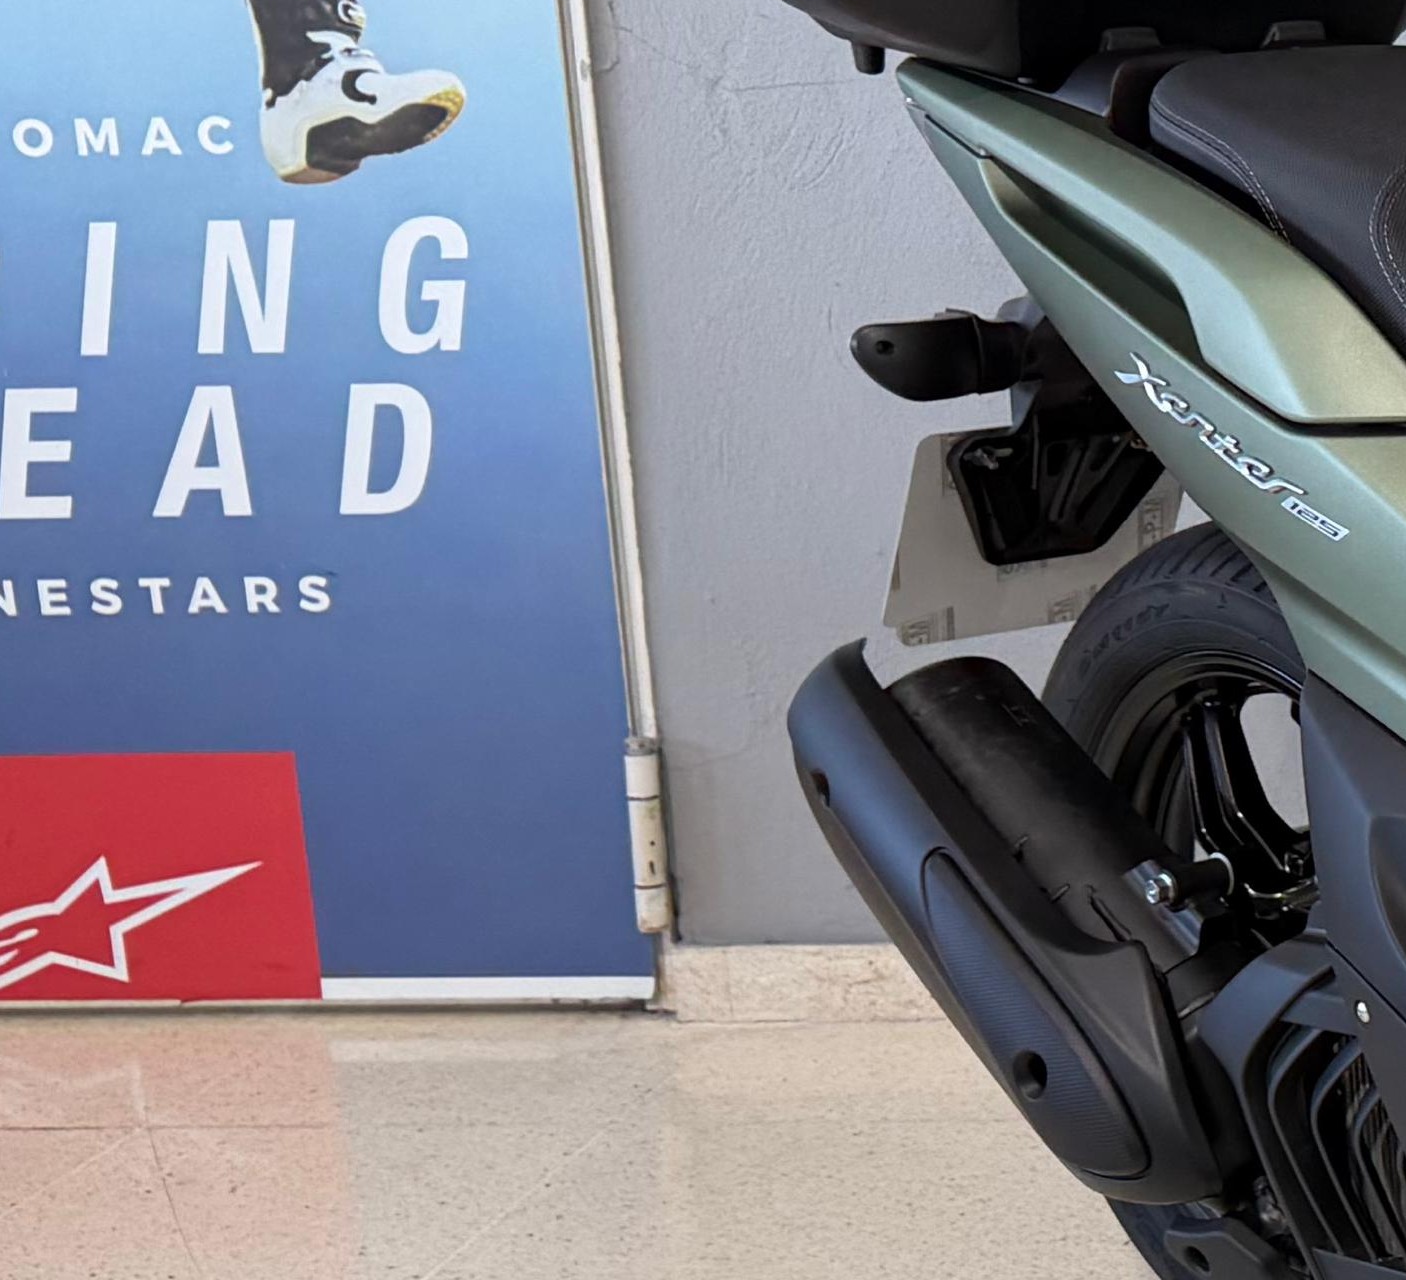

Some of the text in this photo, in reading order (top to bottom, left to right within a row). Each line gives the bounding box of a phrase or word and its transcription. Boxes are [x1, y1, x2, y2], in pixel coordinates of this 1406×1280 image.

[12, 115, 235, 158] OMAC
[80, 215, 470, 356] ING
[0, 382, 434, 519] EAD
[1114, 352, 1306, 495] Xenter
[1287, 499, 1345, 539] 125
